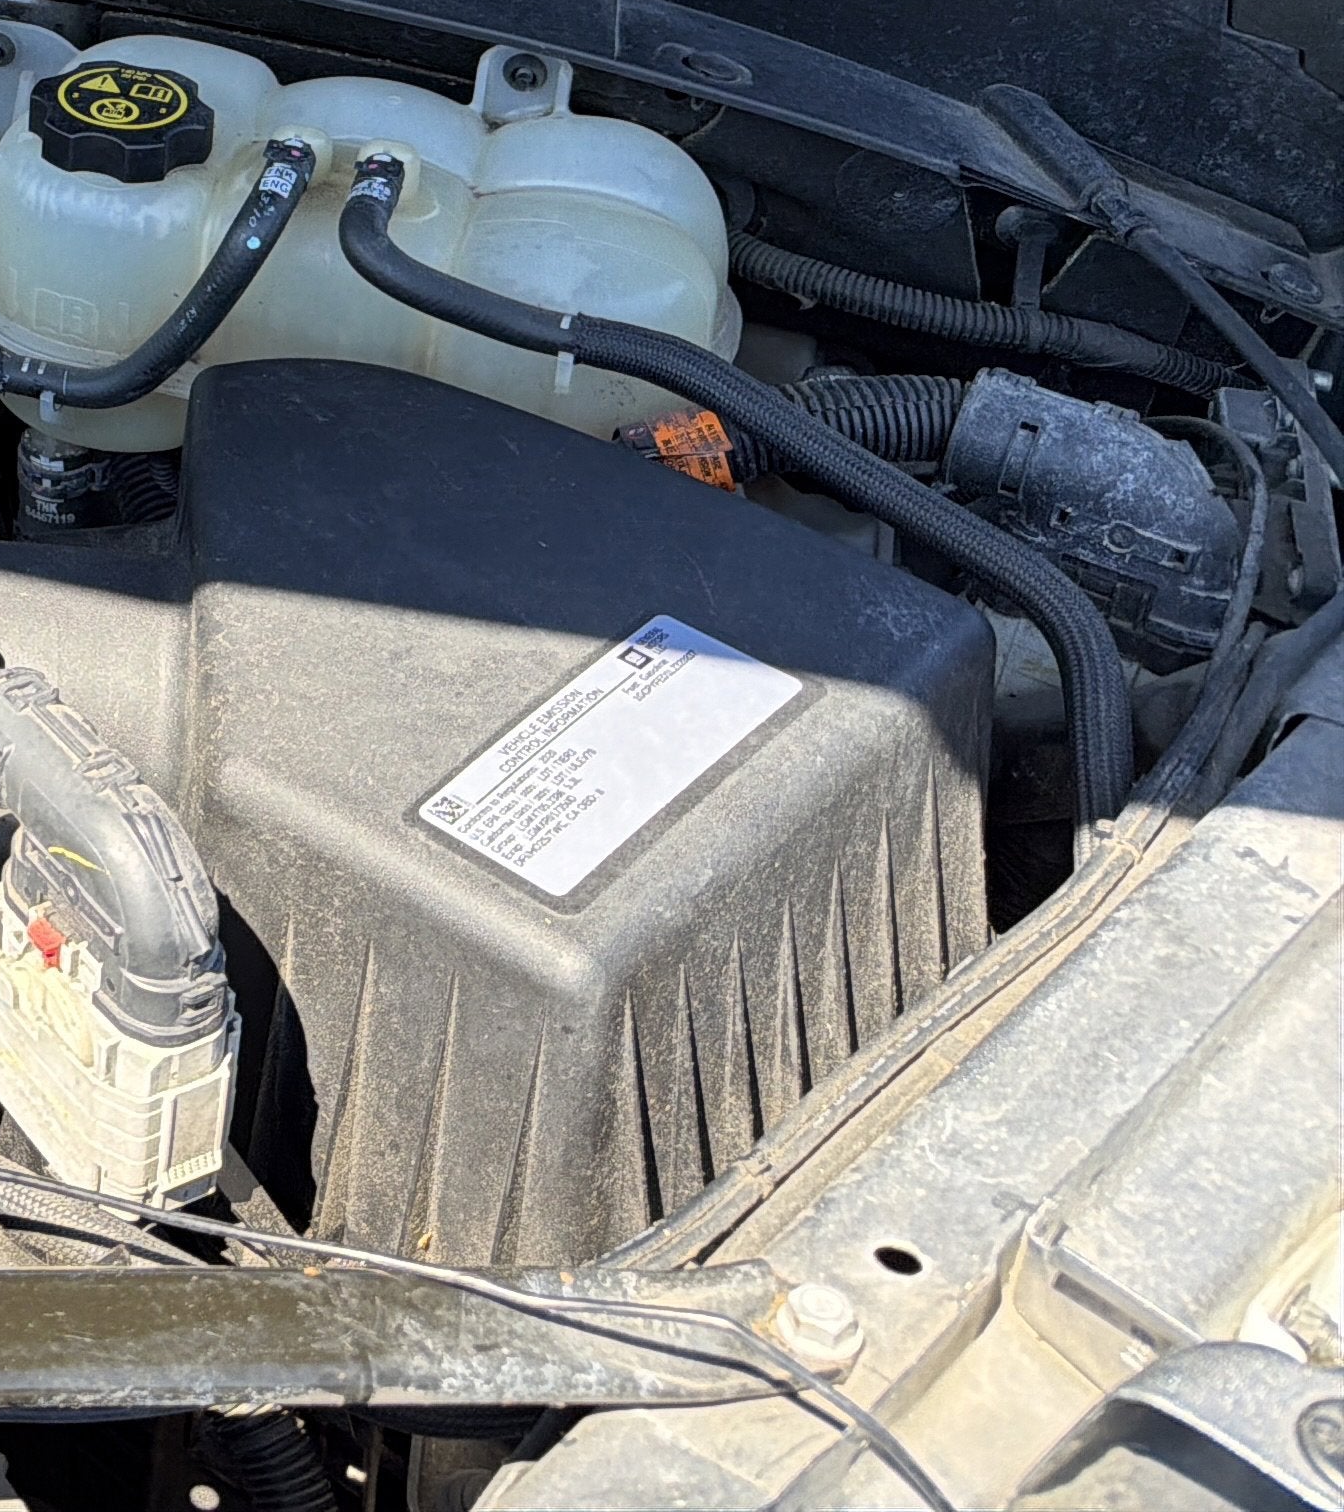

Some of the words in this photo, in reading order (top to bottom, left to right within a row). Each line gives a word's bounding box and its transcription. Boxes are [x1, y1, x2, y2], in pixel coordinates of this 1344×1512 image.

[261, 178, 290, 194] ENG
[499, 723, 541, 755] VEHICLE
[536, 689, 582, 725] EMISSION
[499, 737, 546, 773] CONTROL
[542, 689, 604, 737] INFORMATION
